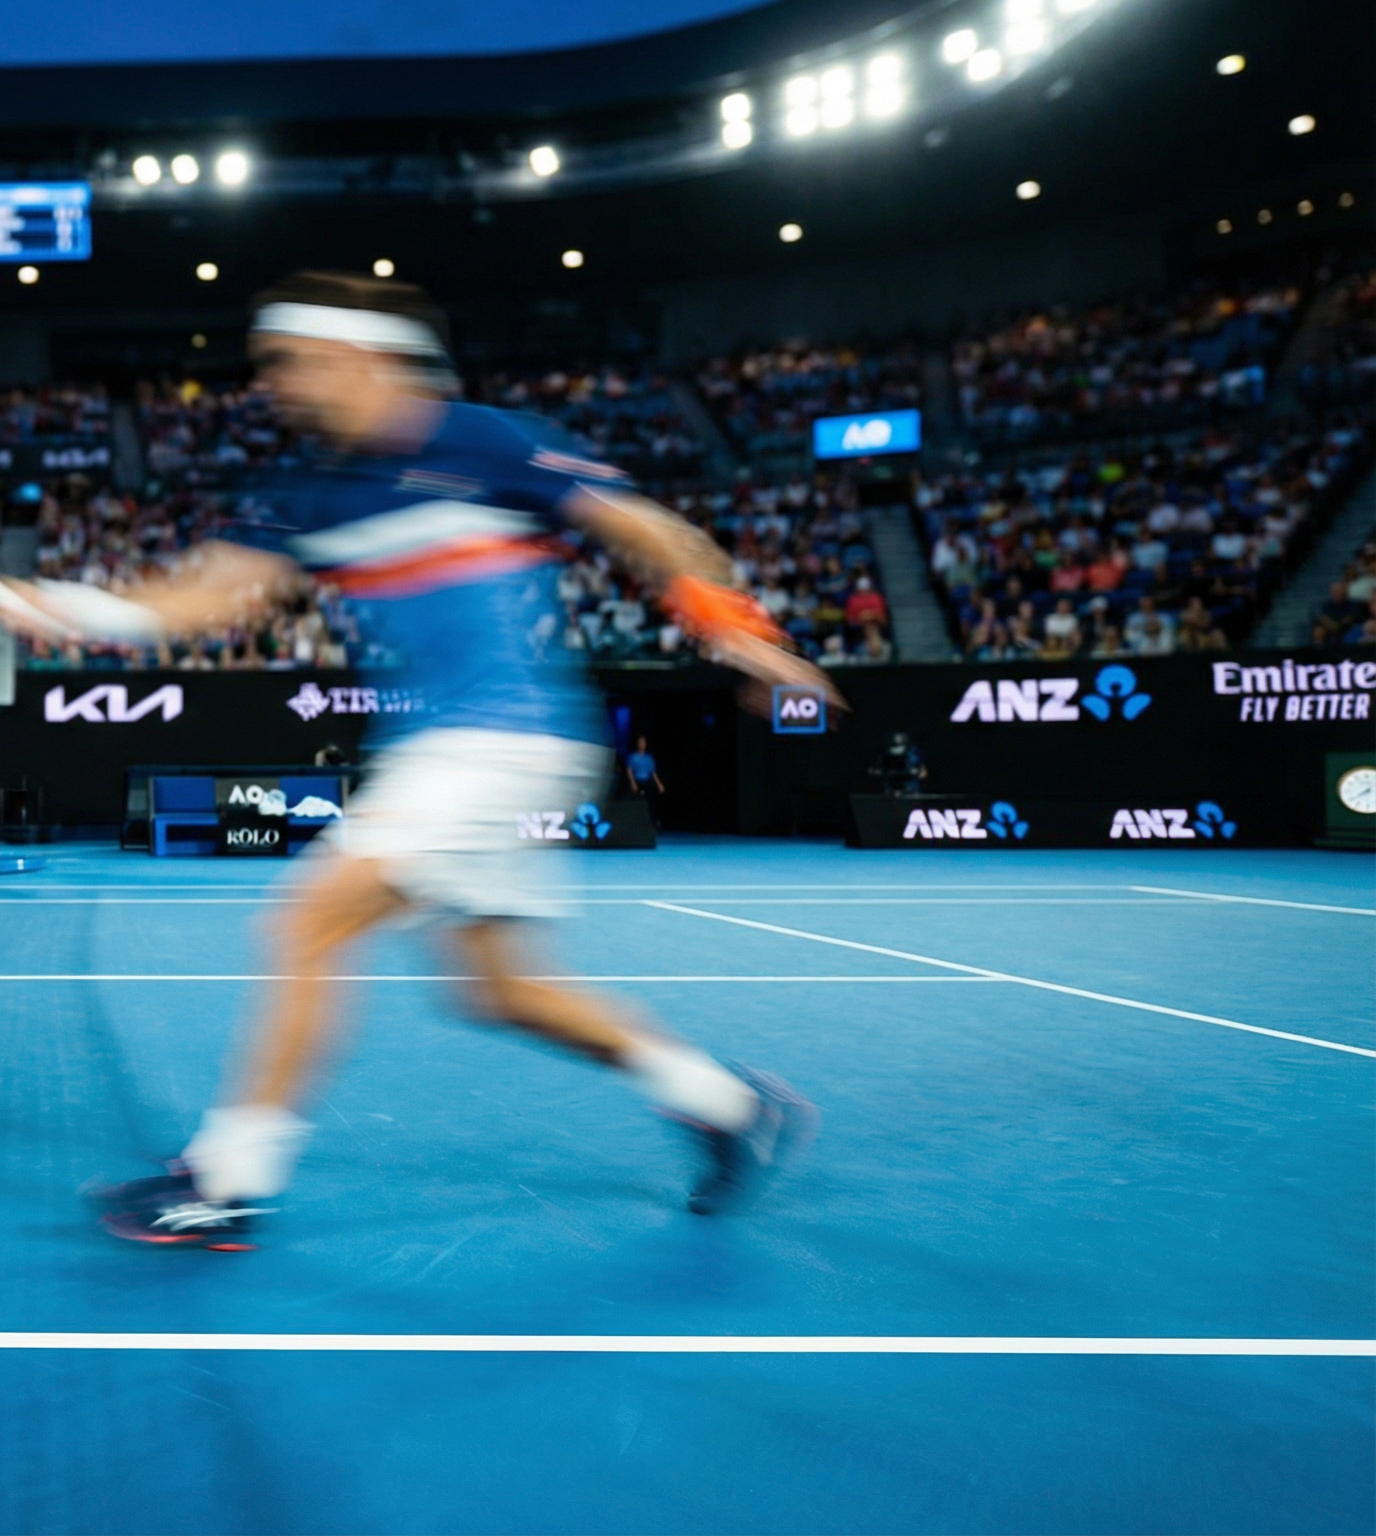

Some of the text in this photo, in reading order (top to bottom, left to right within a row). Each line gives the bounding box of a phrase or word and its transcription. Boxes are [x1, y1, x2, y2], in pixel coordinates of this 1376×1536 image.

[44, 684, 183, 722] KIA
[780, 697, 818, 718] AO
[950, 679, 1080, 722] ANZ
[1240, 693, 1370, 722] FLY BETTER
[515, 811, 570, 839] NZ
[903, 809, 988, 839] ANZ
[1109, 809, 1195, 839] ANZ
